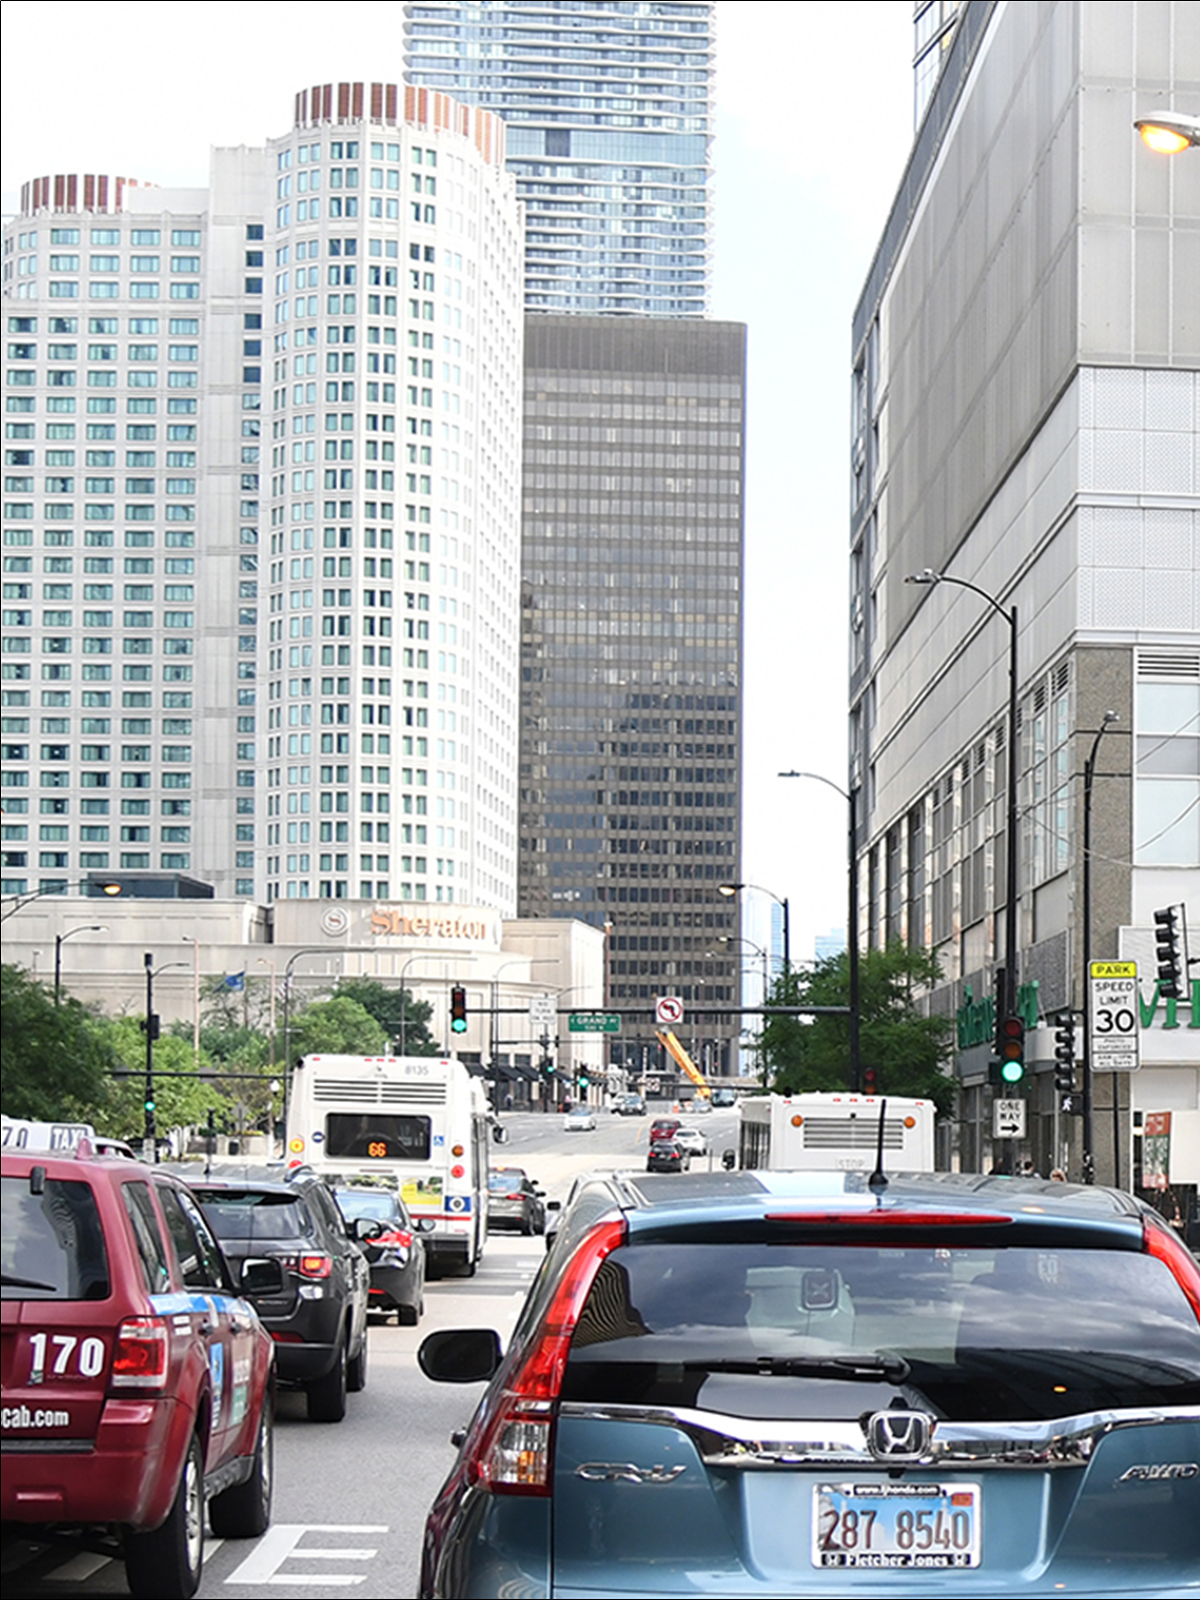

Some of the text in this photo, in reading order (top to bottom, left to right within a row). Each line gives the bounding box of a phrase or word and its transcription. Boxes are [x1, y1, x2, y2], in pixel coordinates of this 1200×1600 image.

[370, 909, 486, 940] Sheraton
[1096, 965, 1131, 975] PARK
[1095, 981, 1134, 992] SPEED
[1099, 995, 1129, 1006] LIMIT
[577, 1015, 607, 1025] GRAND
[1096, 1008, 1135, 1033] 30
[404, 1064, 430, 1076] 8135
[1000, 1101, 1020, 1111] ONE
[1000, 1112, 1020, 1121] WAY
[368, 1141, 387, 1158] 66
[29, 1332, 105, 1378] 170
[1, 1404, 70, 1429] cab.com
[574, 1462, 687, 1484] CR-V
[1119, 1463, 1200, 1481] AWD
[824, 1509, 970, 1550] 287 8540
[849, 1554, 949, 1568] Fletcher Jones
